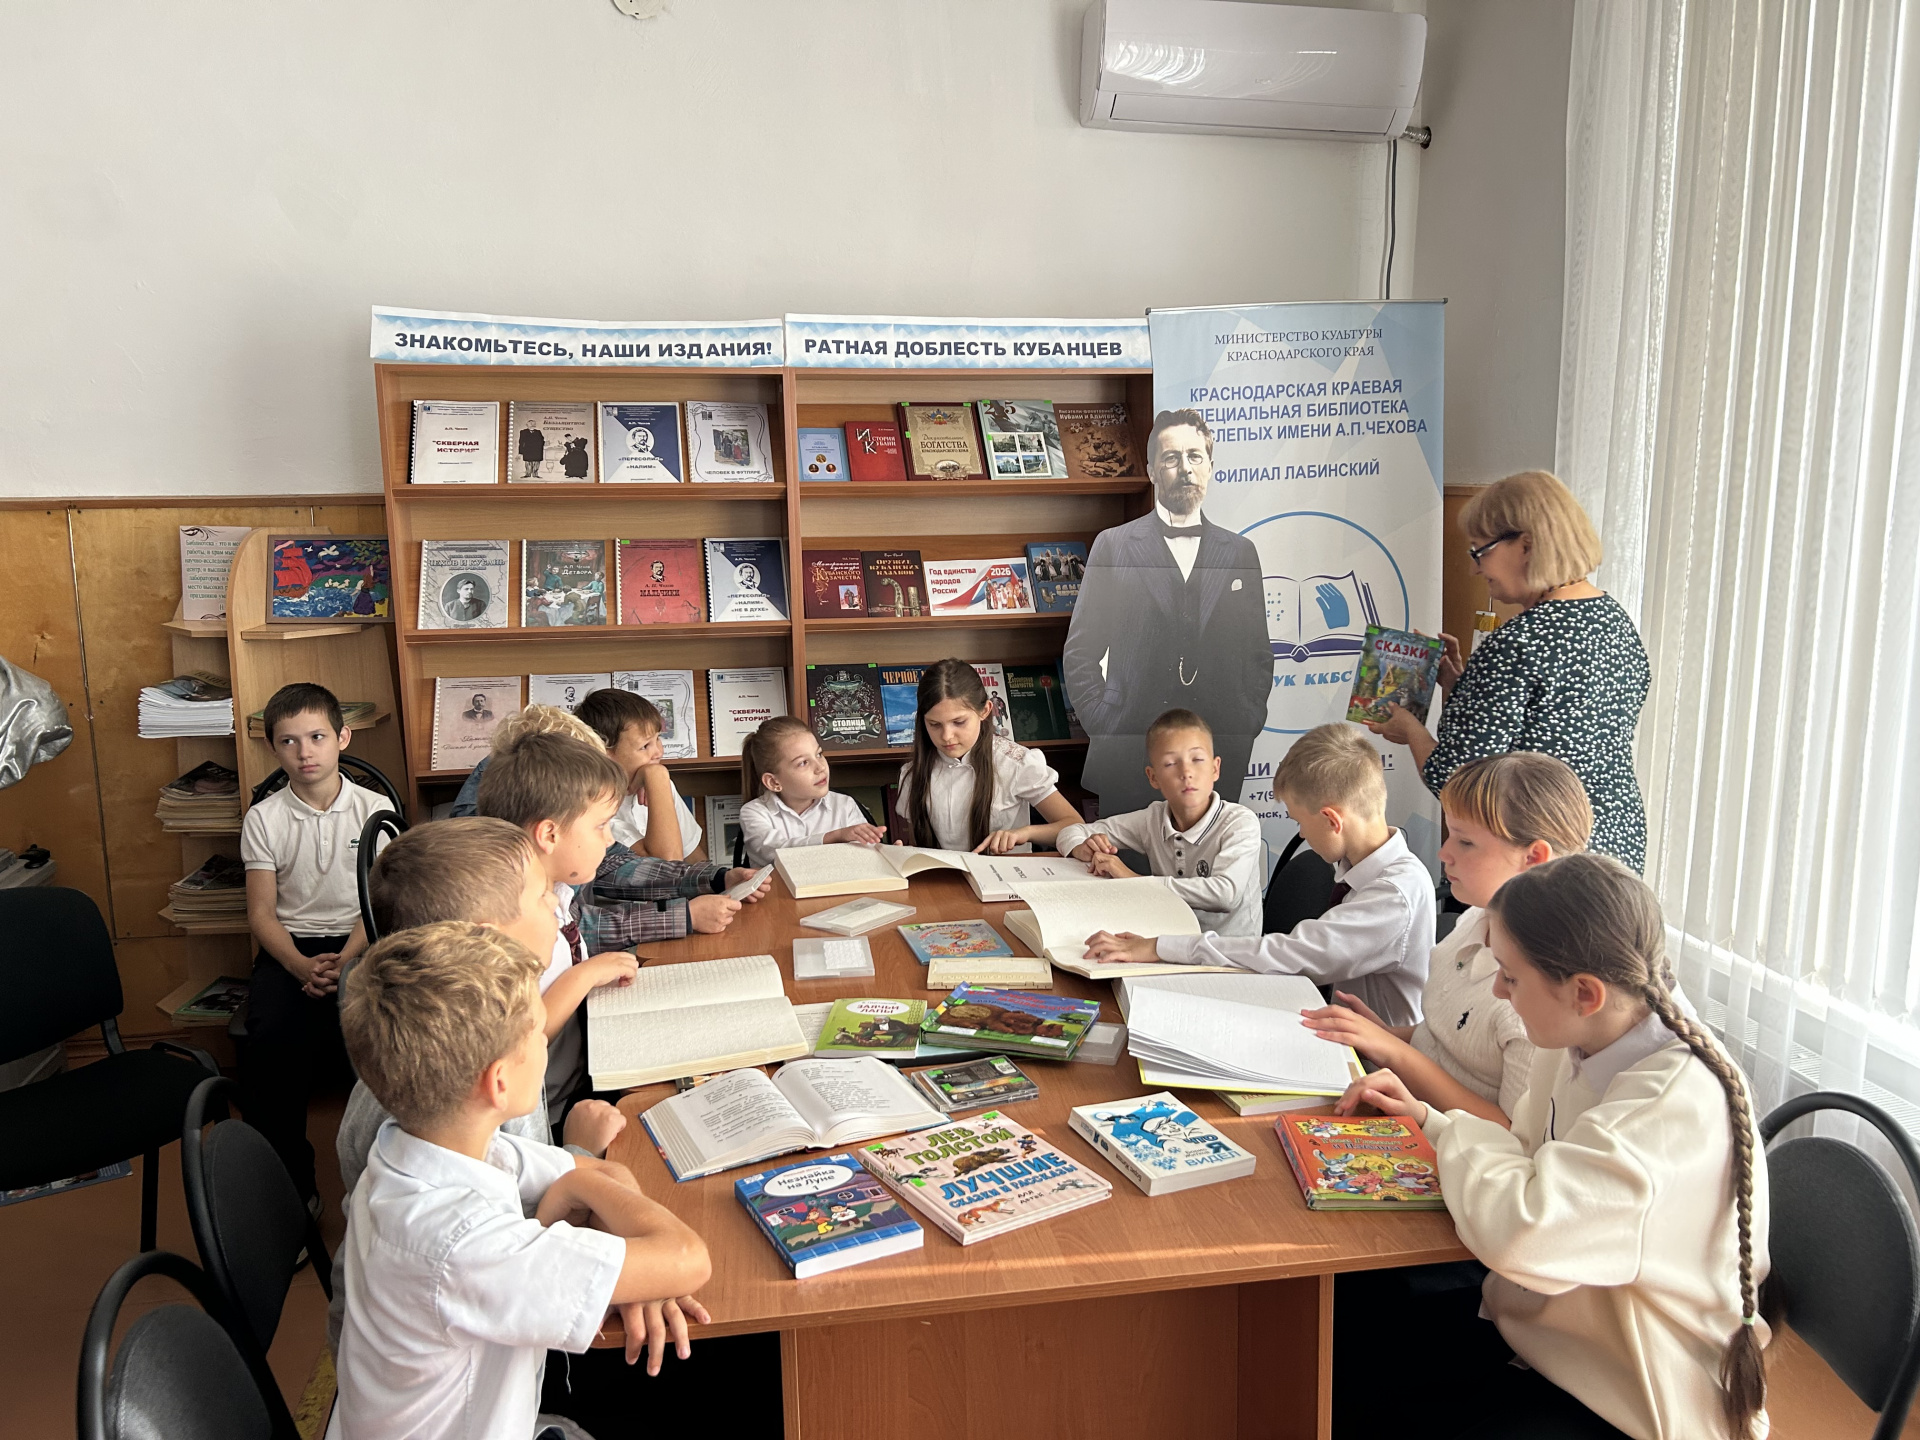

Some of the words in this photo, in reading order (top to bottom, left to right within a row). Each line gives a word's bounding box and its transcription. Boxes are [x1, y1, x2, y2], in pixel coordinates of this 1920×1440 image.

[1215, 331, 1319, 346] МИНИСТЕРСТВО
[1321, 328, 1383, 342] КУЛЬТУРЫ
[394, 332, 573, 359] ЗНАКОМЬТЕСЬ,
[582, 343, 650, 358] НАШИ
[658, 341, 772, 360] ИЗДАНИЯ!
[804, 339, 887, 355] РАТНАЯ
[894, 341, 1007, 358] ДОБЛЕСТЬ
[1013, 342, 1123, 358] КУБАНЦЕВ
[1227, 348, 1341, 362] КРАСНОДАРСКОГО
[1344, 345, 1375, 357] КРАЯ
[1190, 382, 1327, 402] КРАСНОДАРСКАЯ
[1331, 379, 1403, 396] КРАЕВАЯ
[1195, 404, 1301, 424] ПЕЦИАЛЬНАЯ
[1306, 400, 1409, 418] БИБЛИОТЕКА
[1277, 424, 1332, 440] ИМЕНИ
[1335, 419, 1428, 437] А.П.ЧЕХОВА
[1214, 466, 1280, 484] ФИЛИАЛ
[1284, 458, 1380, 480] ЛАБИНСКИЙ
[929, 568, 942, 576] Год
[943, 568, 977, 576] единства
[990, 567, 1012, 576] 2026
[931, 578, 961, 586] народов
[1374, 639, 1430, 659] СКАЗКИ
[882, 671, 919, 683] ЧЕРНОЕ
[1304, 670, 1353, 686] ККБС
[832, 719, 865, 727] СТОЛИЦА
[925, 1126, 975, 1147] ЛЕВ
[1183, 1134, 1219, 1145] ЧТО
[904, 1126, 1016, 1166] ТОЛСТОЙ
[1205, 1140, 1233, 1154] Я
[1184, 1150, 1242, 1167] ВИДЕЛ
[777, 1169, 836, 1186] Незнайка
[805, 1174, 835, 1186] Луне
[939, 1151, 1067, 1200] ЛУЧШИЕ
[948, 1188, 999, 1208] СКАЗКИ
[999, 1184, 1012, 1193] И
[1012, 1164, 1079, 1190] РАССКАЗЫ
